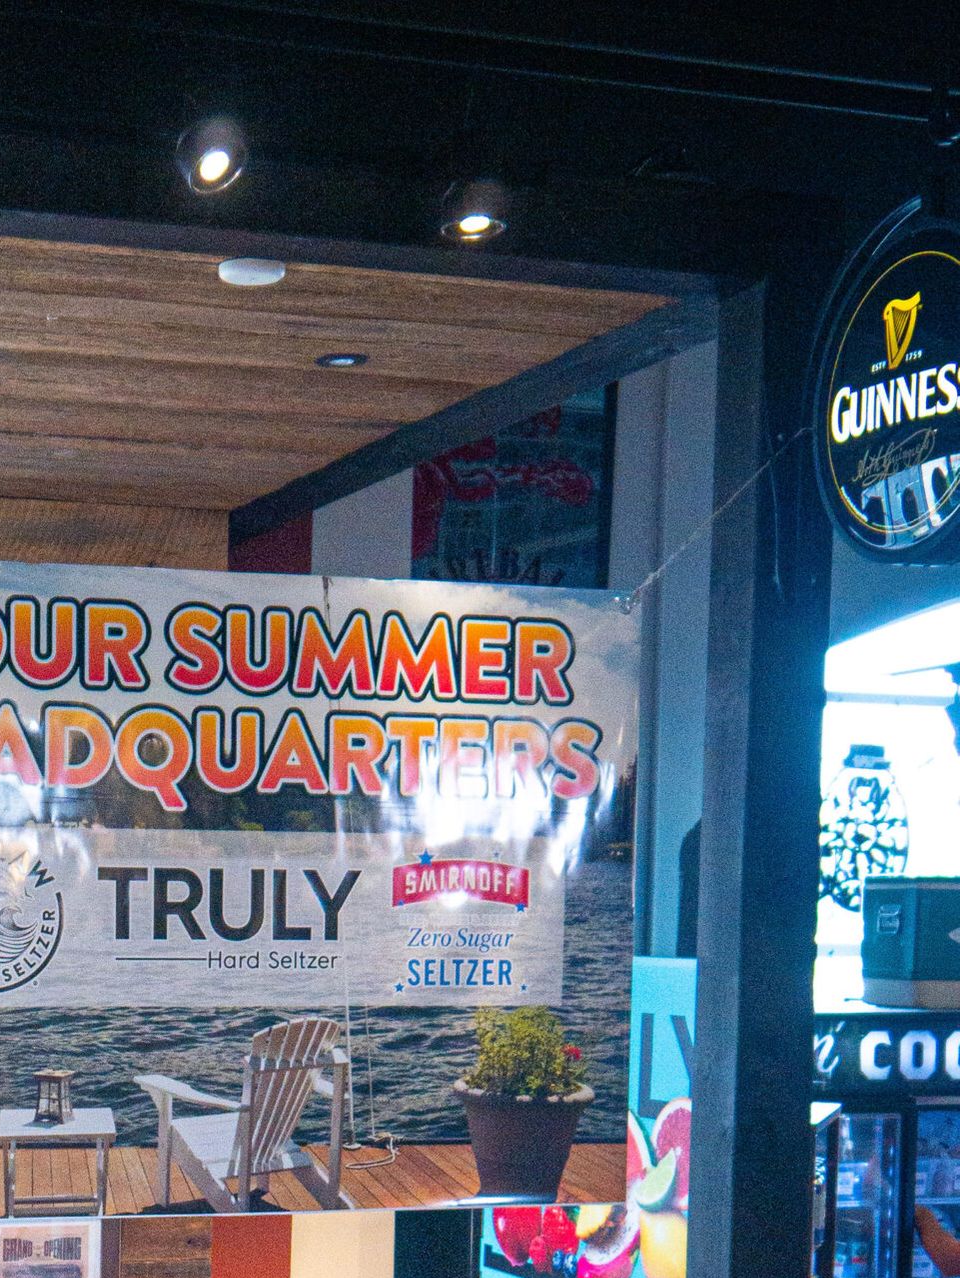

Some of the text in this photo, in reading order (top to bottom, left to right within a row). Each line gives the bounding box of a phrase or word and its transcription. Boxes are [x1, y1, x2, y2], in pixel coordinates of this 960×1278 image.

[905, 350, 922, 361] 1759
[831, 363, 960, 443] GUINNES
[164, 602, 575, 705] SUMMER
[405, 867, 517, 895] SMIRNOFF
[97, 867, 362, 941] TRULY
[2, 909, 56, 982] SELTZER
[406, 927, 514, 952] Zero Sugar
[208, 951, 338, 969] Hard Seltzer
[407, 958, 513, 986] SELTZER
[3, 1238, 33, 1262] GRAND
